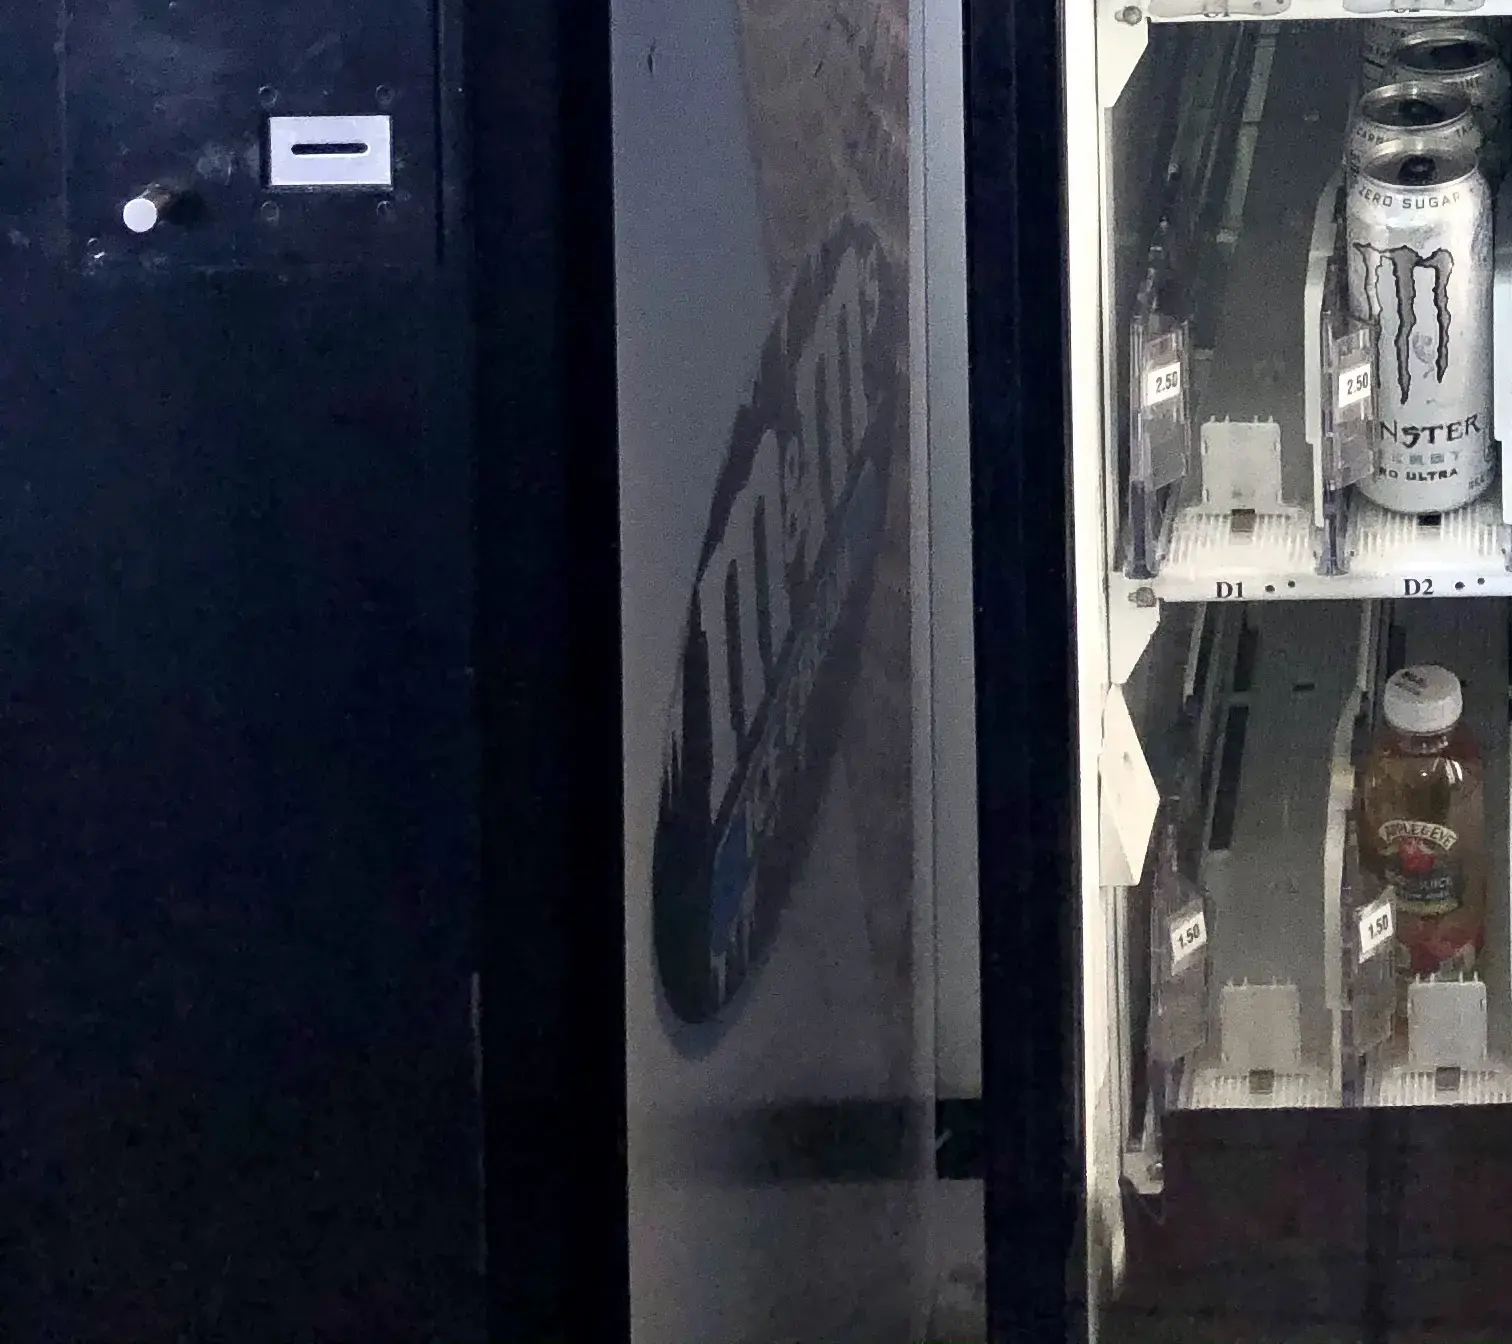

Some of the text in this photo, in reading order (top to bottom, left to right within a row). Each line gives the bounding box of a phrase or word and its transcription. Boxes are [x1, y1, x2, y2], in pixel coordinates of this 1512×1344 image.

[1358, 186, 1461, 210] ZERO SUGAR
[1154, 371, 1179, 394] 2.50
[1346, 372, 1369, 395] 2.50
[1379, 414, 1481, 449] NSTER
[1405, 467, 1458, 481] ULTRA
[1215, 580, 1245, 598] D1
[1403, 578, 1435, 596] D2
[1177, 924, 1201, 949] 1.50
[1367, 914, 1389, 940] 1.50
